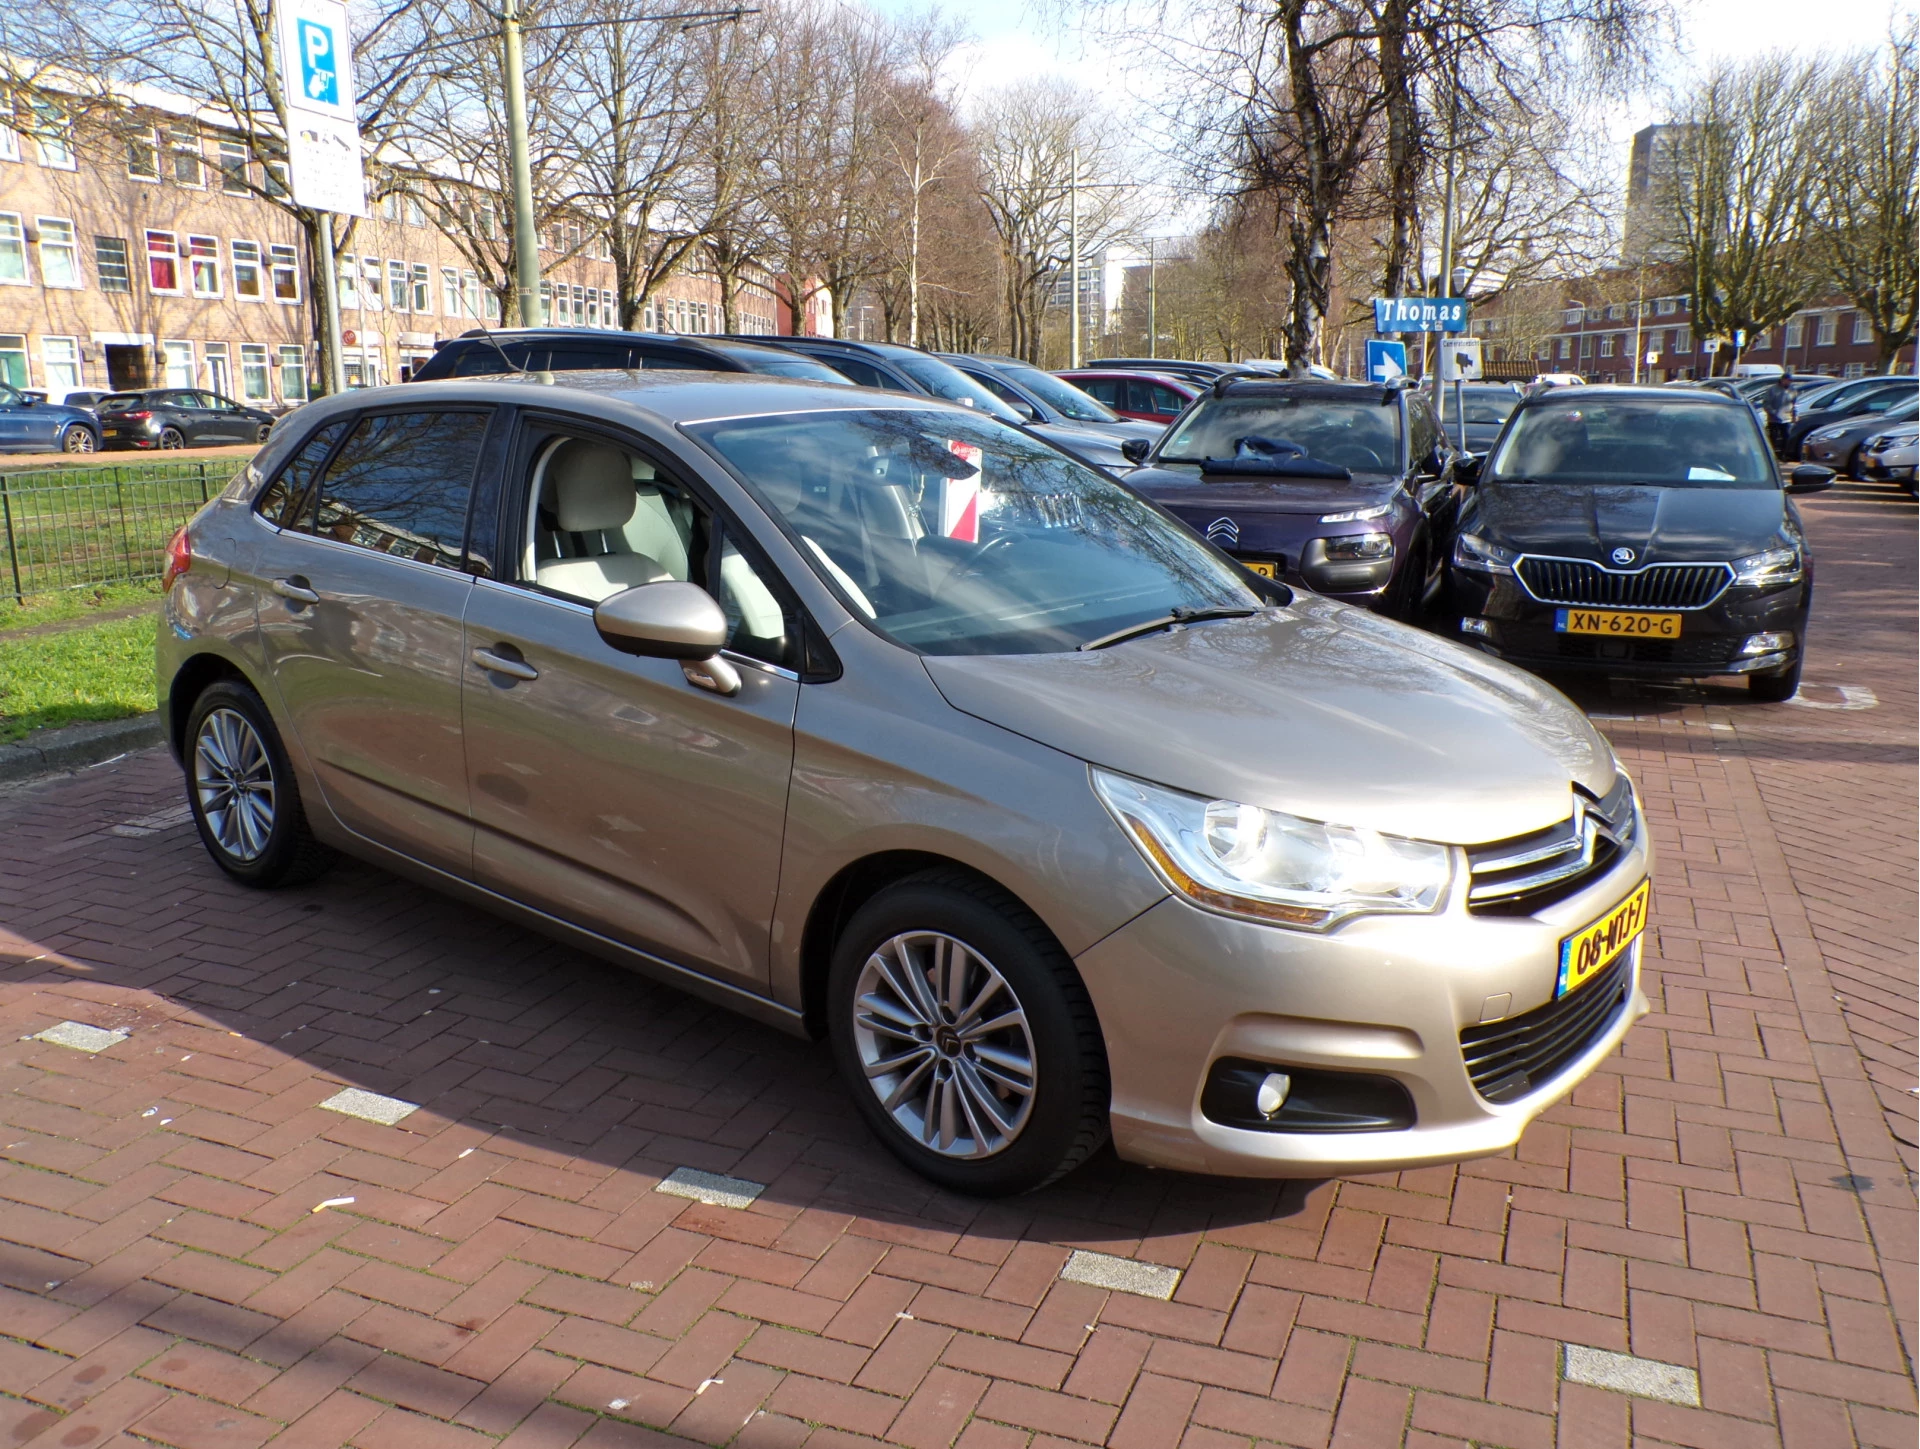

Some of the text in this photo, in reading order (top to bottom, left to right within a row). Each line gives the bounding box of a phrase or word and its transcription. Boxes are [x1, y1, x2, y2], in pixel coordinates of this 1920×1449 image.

[304, 24, 329, 69] P
[1382, 299, 1461, 321] Thomas
[1572, 612, 1673, 635] XN-620-G
[1577, 890, 1645, 975] 08-NTJ-7
